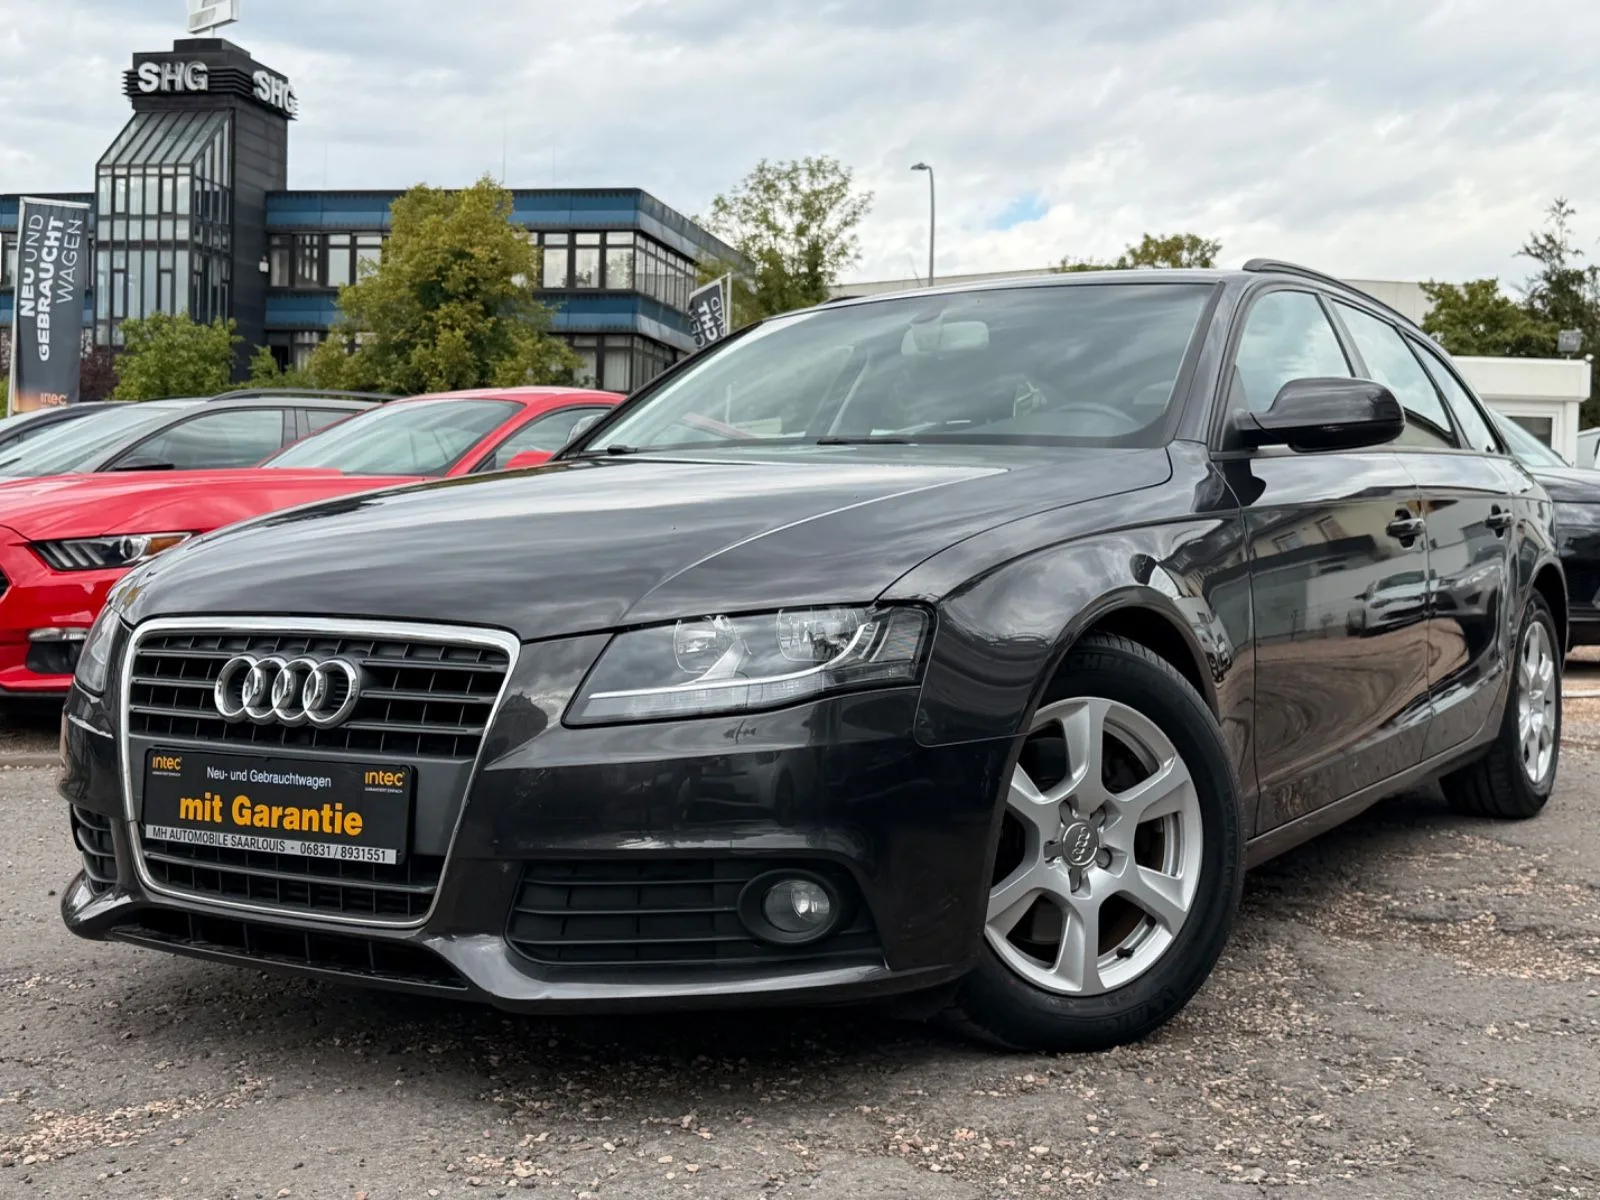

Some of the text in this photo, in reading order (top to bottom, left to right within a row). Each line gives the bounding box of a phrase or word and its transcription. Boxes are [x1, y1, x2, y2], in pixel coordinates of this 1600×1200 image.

[137, 61, 209, 93] SHG
[252, 70, 297, 114] SHG
[20, 214, 44, 317] NEU UND
[56, 218, 83, 304] WAGEN
[37, 216, 65, 362] GEBRAUCHT
[152, 756, 182, 770] intec
[206, 766, 331, 790] Neu- und Gebrauchtwagen
[364, 770, 404, 786] intec
[179, 792, 363, 836] mit Garantie
[152, 826, 168, 839] MH
[169, 829, 228, 847] AUTOMOBILE
[230, 838, 286, 853] SAARLOUIS
[300, 843, 331, 858] 06831
[340, 847, 386, 863] 8931551
